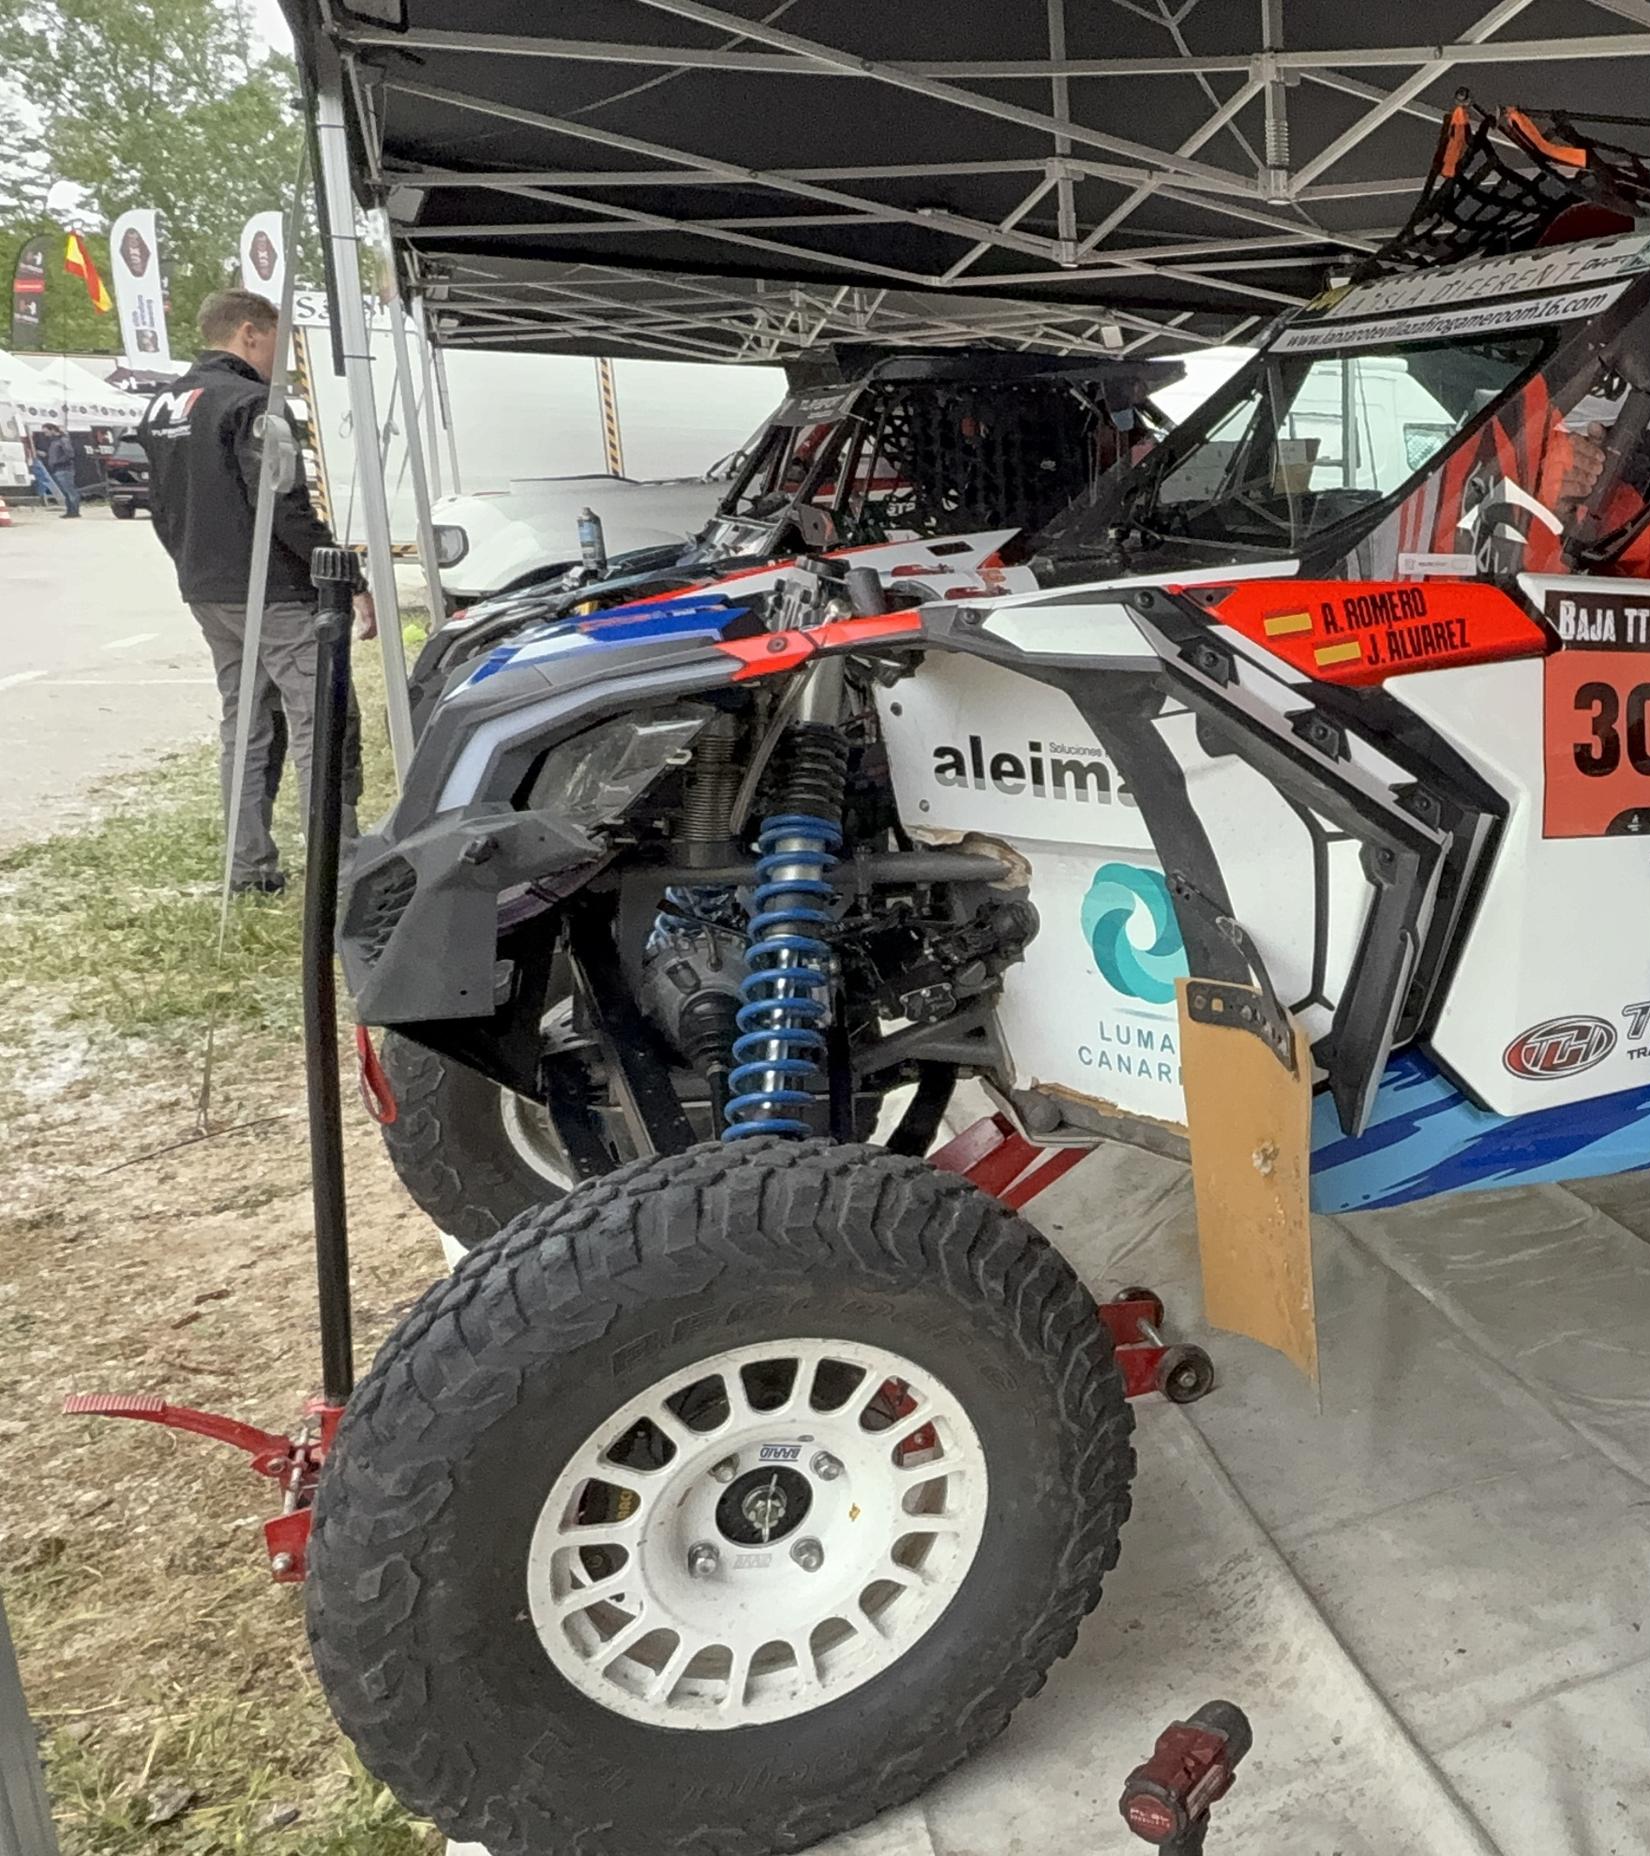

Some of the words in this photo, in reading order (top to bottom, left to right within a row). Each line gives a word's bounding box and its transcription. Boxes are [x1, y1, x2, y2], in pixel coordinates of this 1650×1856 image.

[1321, 602, 1344, 634] A.
[1343, 587, 1428, 631] ROMERO
[1559, 600, 1617, 643] BAJA
[1624, 608, 1650, 643] TT
[1368, 633, 1387, 665] J.
[1049, 742, 1103, 757] Soluciones
[1099, 1020, 1176, 1055] LUMA
